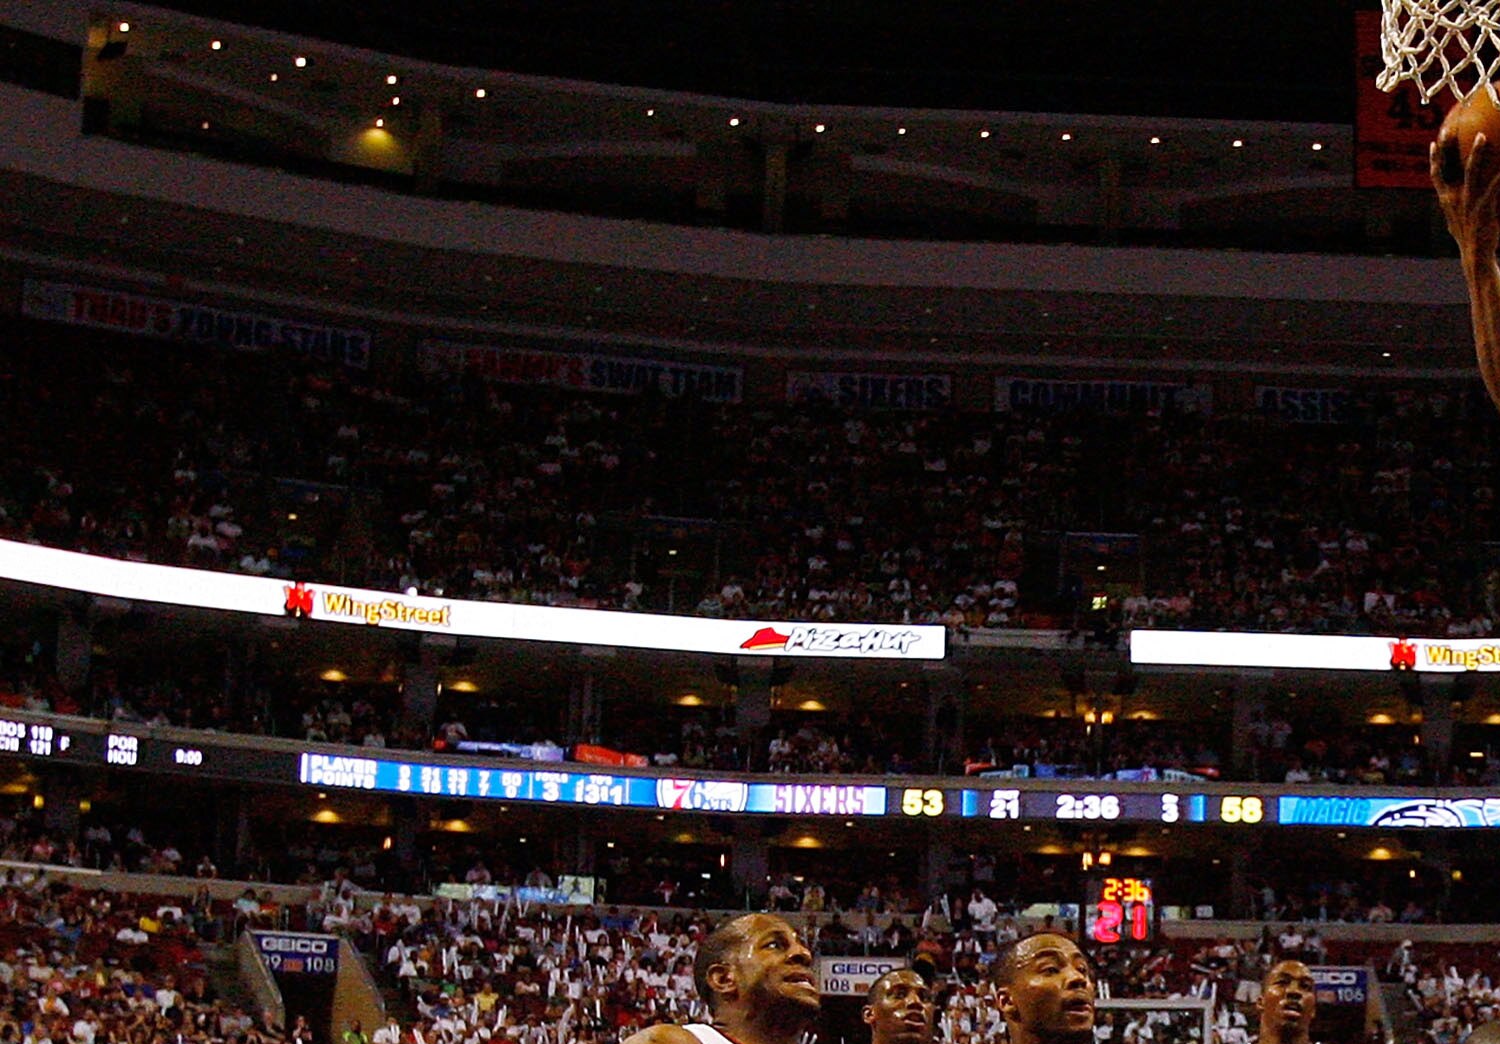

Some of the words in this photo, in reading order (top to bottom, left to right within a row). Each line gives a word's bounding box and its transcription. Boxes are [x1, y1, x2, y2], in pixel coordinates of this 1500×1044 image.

[322, 591, 451, 626] WingStreet
[109, 734, 138, 751] POR
[311, 754, 377, 775] PLAYER
[311, 769, 376, 789] POINTS
[542, 782, 560, 804] 3
[774, 785, 865, 814] SIXERS
[903, 789, 944, 816] 53
[990, 799, 1019, 819] 21
[1056, 794, 1119, 820] 2:36
[1161, 802, 1178, 823] 3
[1221, 796, 1263, 823] 58
[1292, 798, 1370, 824] MAGIC
[1103, 878, 1151, 901] 2:36
[1094, 900, 1147, 943] 21
[262, 937, 328, 954] GEICO
[824, 978, 850, 993] 108
